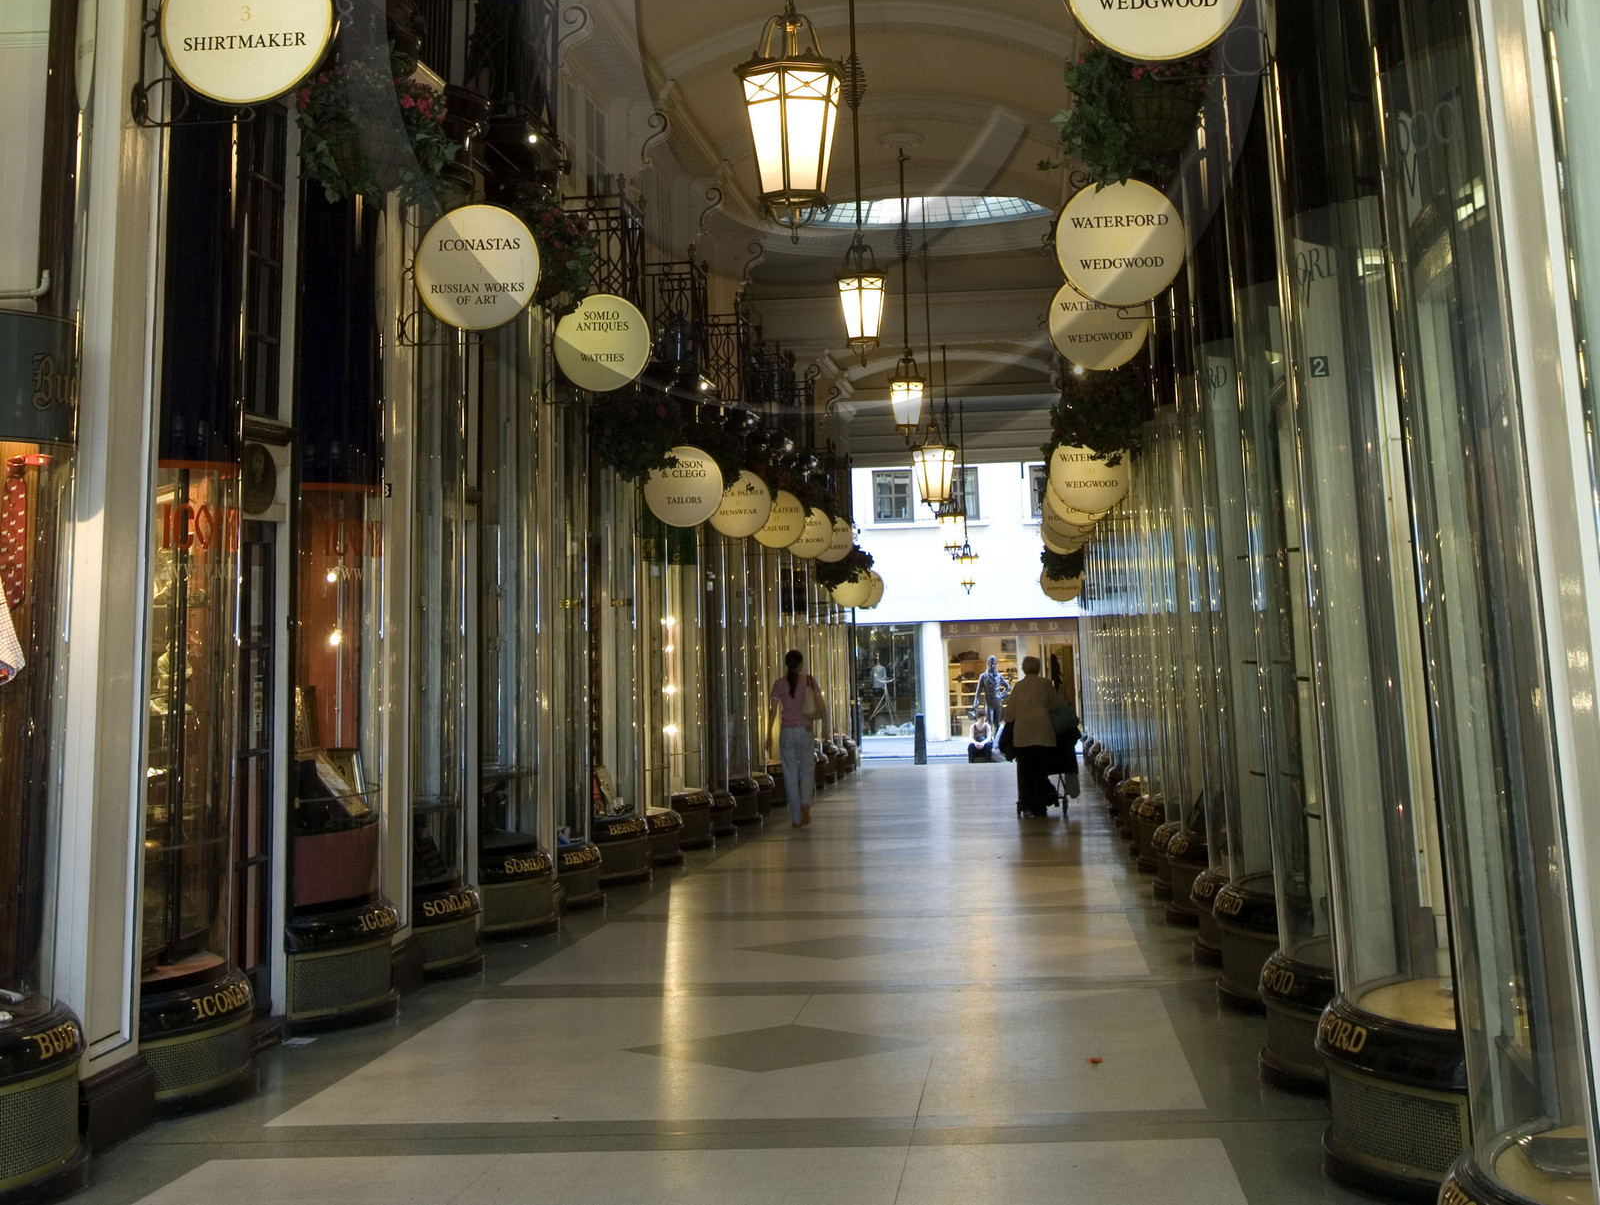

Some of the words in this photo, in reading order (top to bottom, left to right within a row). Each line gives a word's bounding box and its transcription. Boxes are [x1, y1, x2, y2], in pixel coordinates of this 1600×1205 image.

[240, 5, 251, 22] 3
[183, 31, 307, 52] SHIRTMAKER
[1071, 214, 1169, 229] WATERFORD
[438, 238, 521, 252] ICONASTAS
[1079, 256, 1165, 270] WEDGWOOD
[431, 283, 479, 294] RUSSIAN
[484, 282, 525, 292] WORKS
[456, 295, 471, 305] OF
[474, 294, 498, 305] ART
[1060, 301, 1106, 312] WATER
[583, 311, 620, 320] SOMLO
[576, 321, 629, 332] ANTIQUES
[1067, 331, 1133, 344] WEDGWOOD
[580, 353, 625, 362] WATCHES
[1312, 358, 1326, 376] 2
[676, 460, 704, 469] NSON
[672, 470, 706, 478] CLEGG
[1065, 480, 1118, 488] WEDGWOOD
